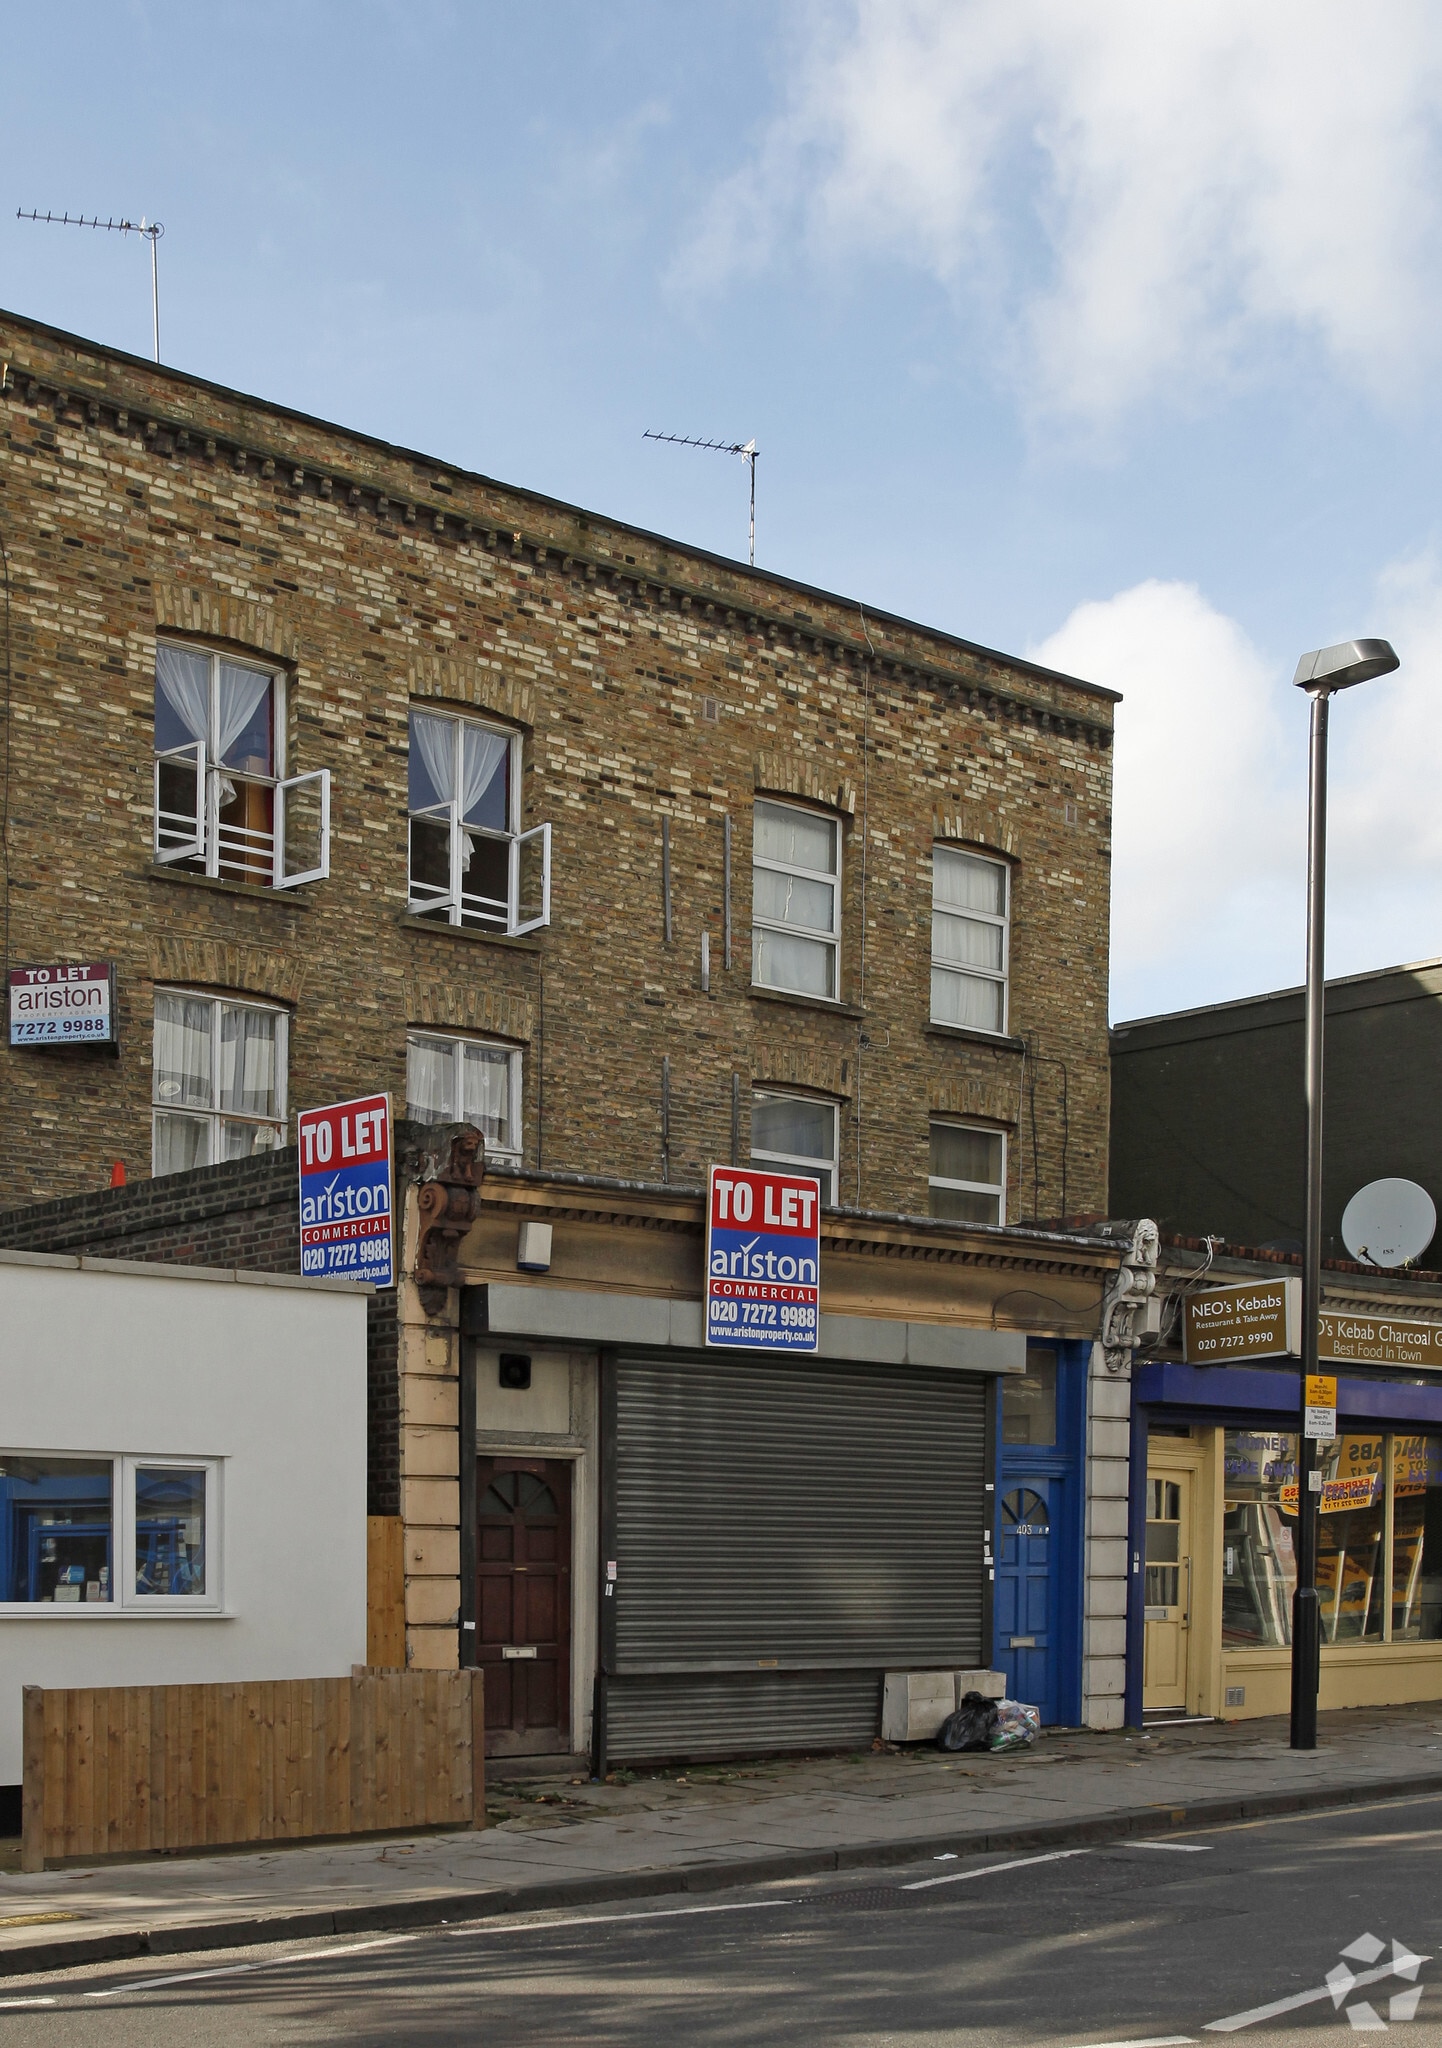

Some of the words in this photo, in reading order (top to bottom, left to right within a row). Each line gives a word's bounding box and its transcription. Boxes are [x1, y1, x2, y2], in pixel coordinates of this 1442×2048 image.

[26, 969, 50, 984] TO
[56, 966, 91, 981] LET
[18, 986, 102, 1010] ariston
[16, 1022, 56, 1035] 7272
[63, 1019, 104, 1032] 9988
[302, 1120, 332, 1165] TO
[341, 1108, 385, 1158] LET
[302, 1174, 389, 1222] ariston
[715, 1179, 753, 1222] TO
[764, 1185, 816, 1228] LET
[304, 1219, 388, 1243] COMMERCIAL
[303, 1248, 325, 1271] 020
[328, 1243, 357, 1268] 7272
[360, 1238, 390, 1263] 9988
[711, 1237, 816, 1282] ariston
[713, 1283, 814, 1301] COMMERCIAL
[710, 1300, 738, 1322] 020
[742, 1303, 777, 1325] 7272
[780, 1306, 816, 1328] 9988
[1192, 1301, 1232, 1318] NEO's
[1236, 1295, 1282, 1312] Kebabs
[1196, 1319, 1234, 1329] Restaurant
[1243, 1315, 1258, 1323] Take
[1259, 1313, 1278, 1321] Away
[710, 1326, 815, 1343] www.aristonproperty.co.uk
[1198, 1339, 1217, 1350] 020
[1220, 1335, 1244, 1348] 7272
[1248, 1331, 1273, 1344] 9990
[1337, 1321, 1374, 1340] Kebab
[1379, 1326, 1430, 1346] Charcoal
[1333, 1340, 1354, 1356] Best
[1358, 1342, 1383, 1358] Food
[1386, 1345, 1394, 1359] In
[1396, 1345, 1422, 1361] Town
